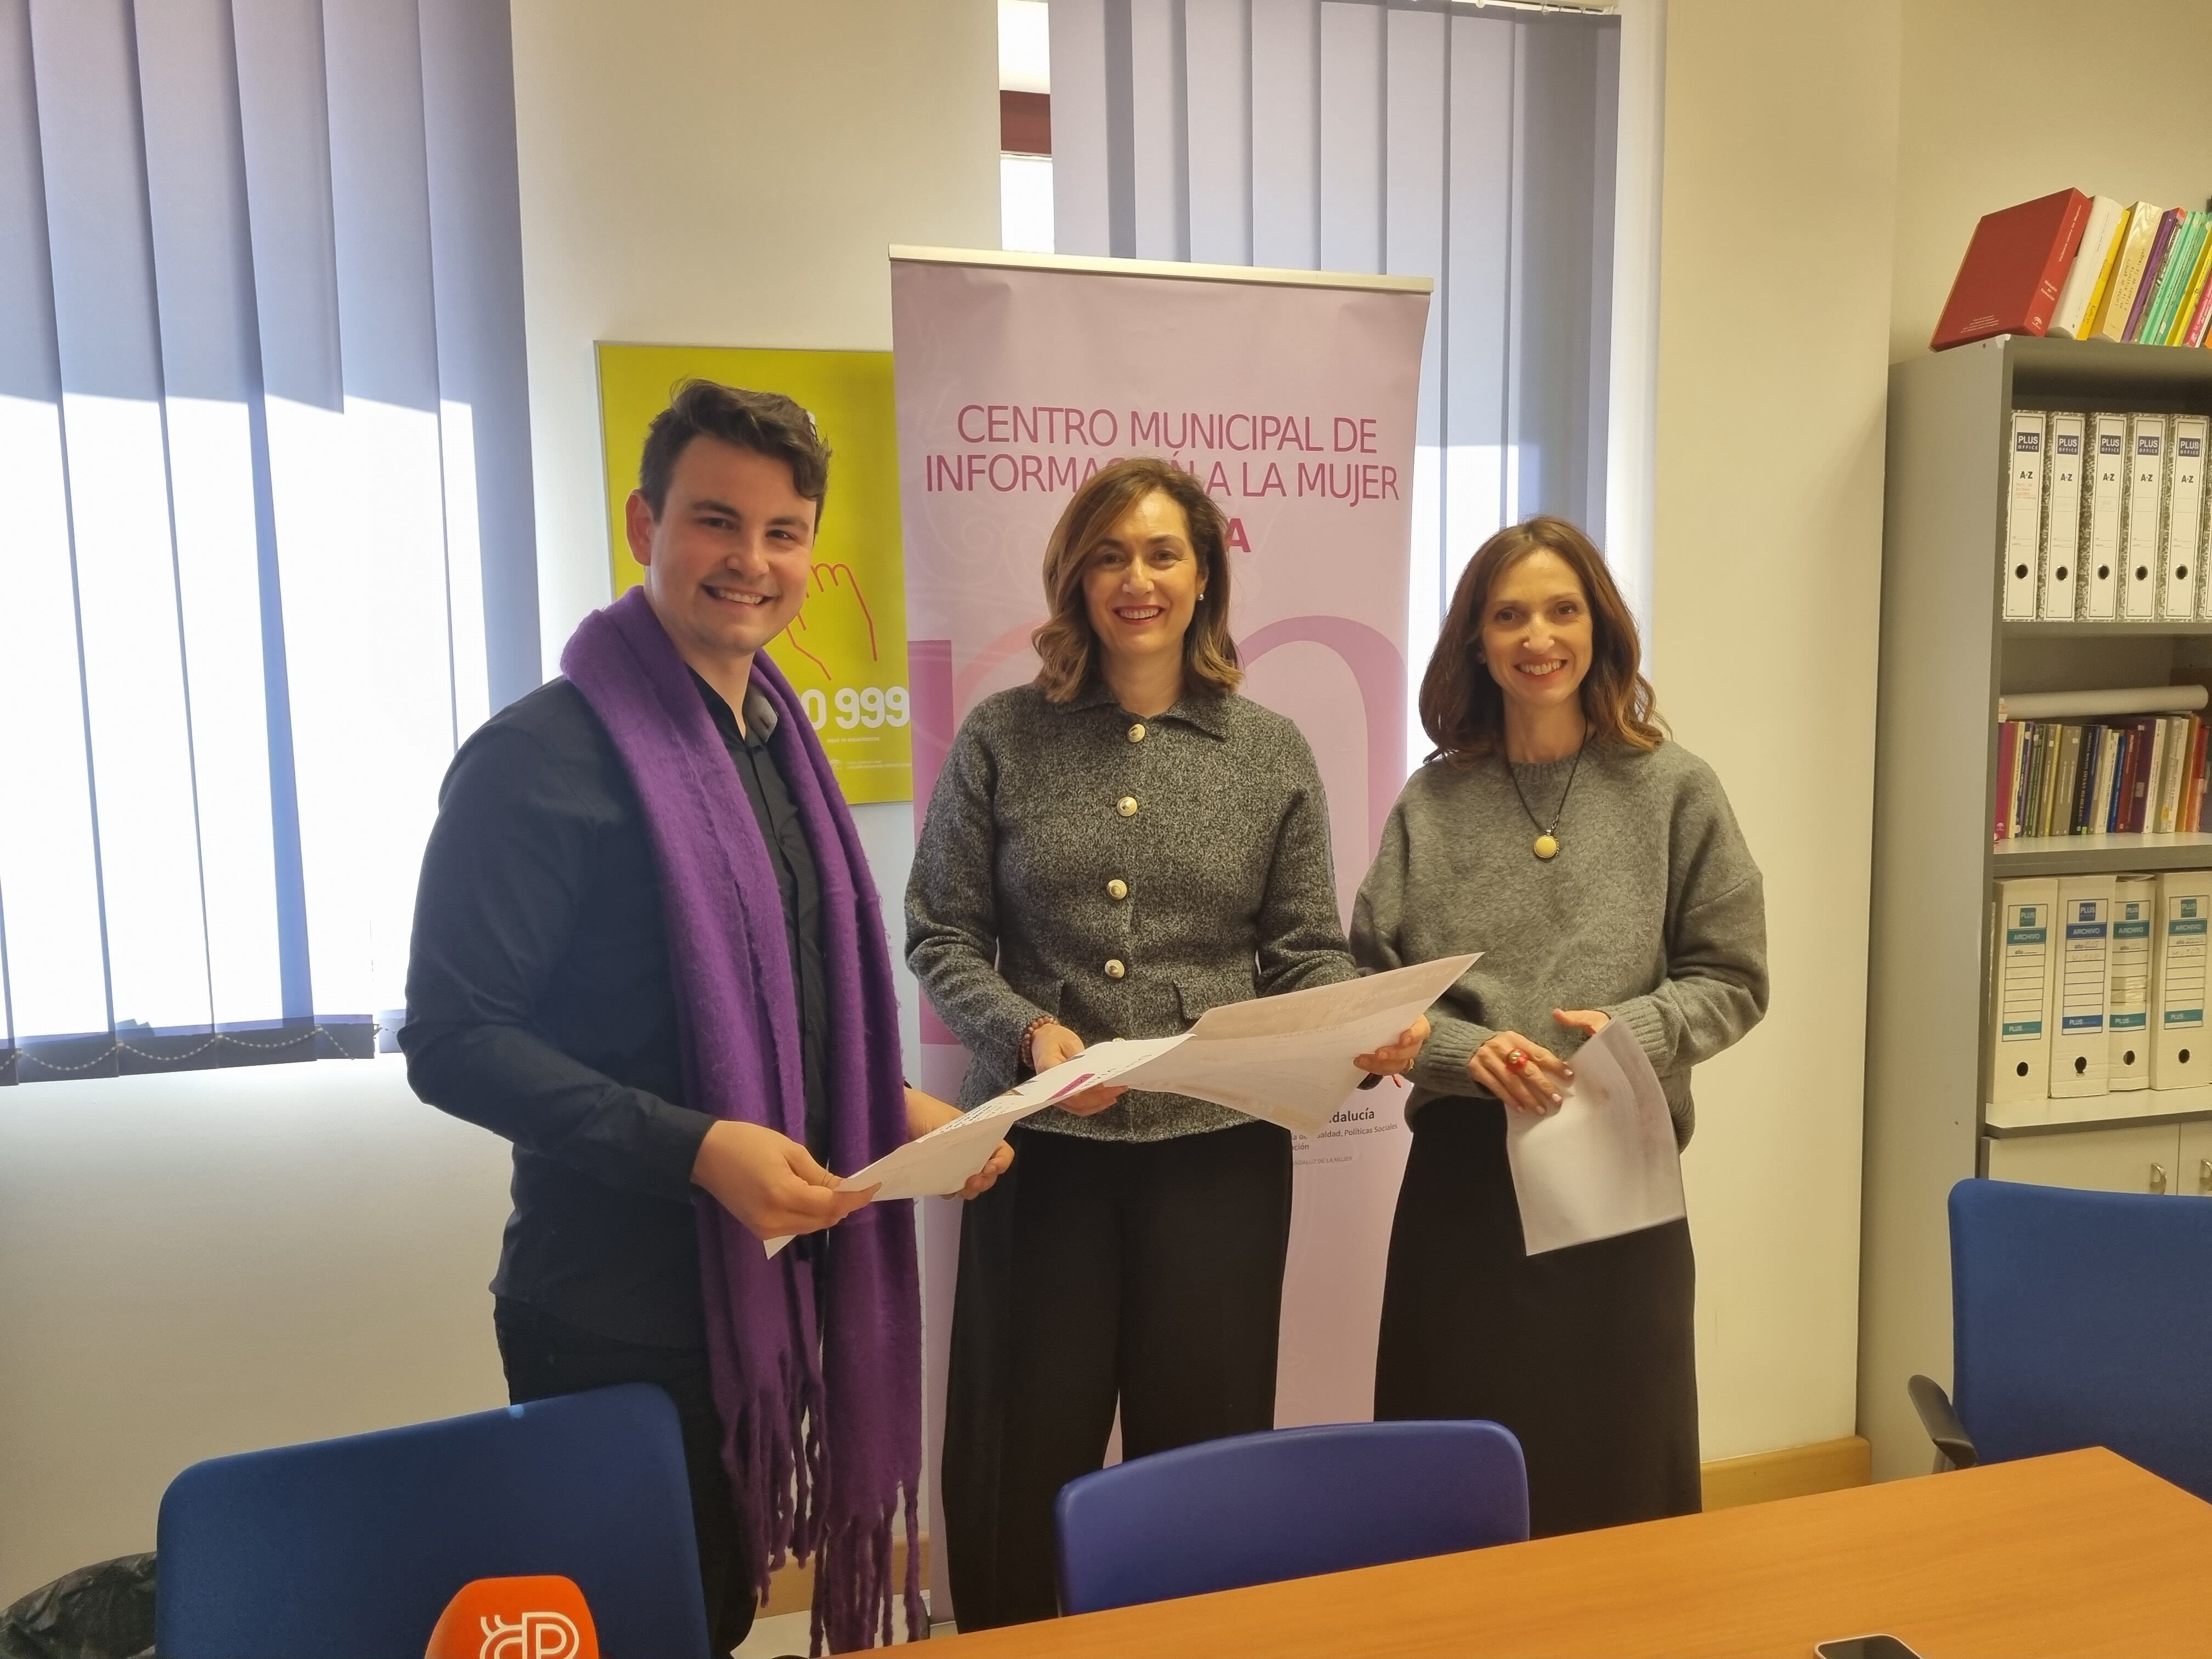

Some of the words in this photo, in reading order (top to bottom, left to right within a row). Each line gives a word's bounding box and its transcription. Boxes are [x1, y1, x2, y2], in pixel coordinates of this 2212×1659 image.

[957, 405, 1118, 445] CENTRO
[1131, 411, 1323, 453] MUNICIPAL
[1333, 417, 1378, 453] DE
[2018, 436, 2038, 444] PLUS
[2058, 438, 2077, 447] PLUS
[2102, 438, 2119, 447] PLUS
[2139, 439, 2158, 448] PLUS
[2180, 441, 2199, 449] PLUS
[1206, 461, 1231, 496] A
[1242, 461, 1287, 498] LA
[1297, 462, 1400, 507] MUJER
[834, 686, 911, 730] 999
[1329, 1108, 1375, 1123] dalucía
[1344, 1128, 1373, 1136] Políticas
[1374, 1124, 1398, 1133] Sociales
